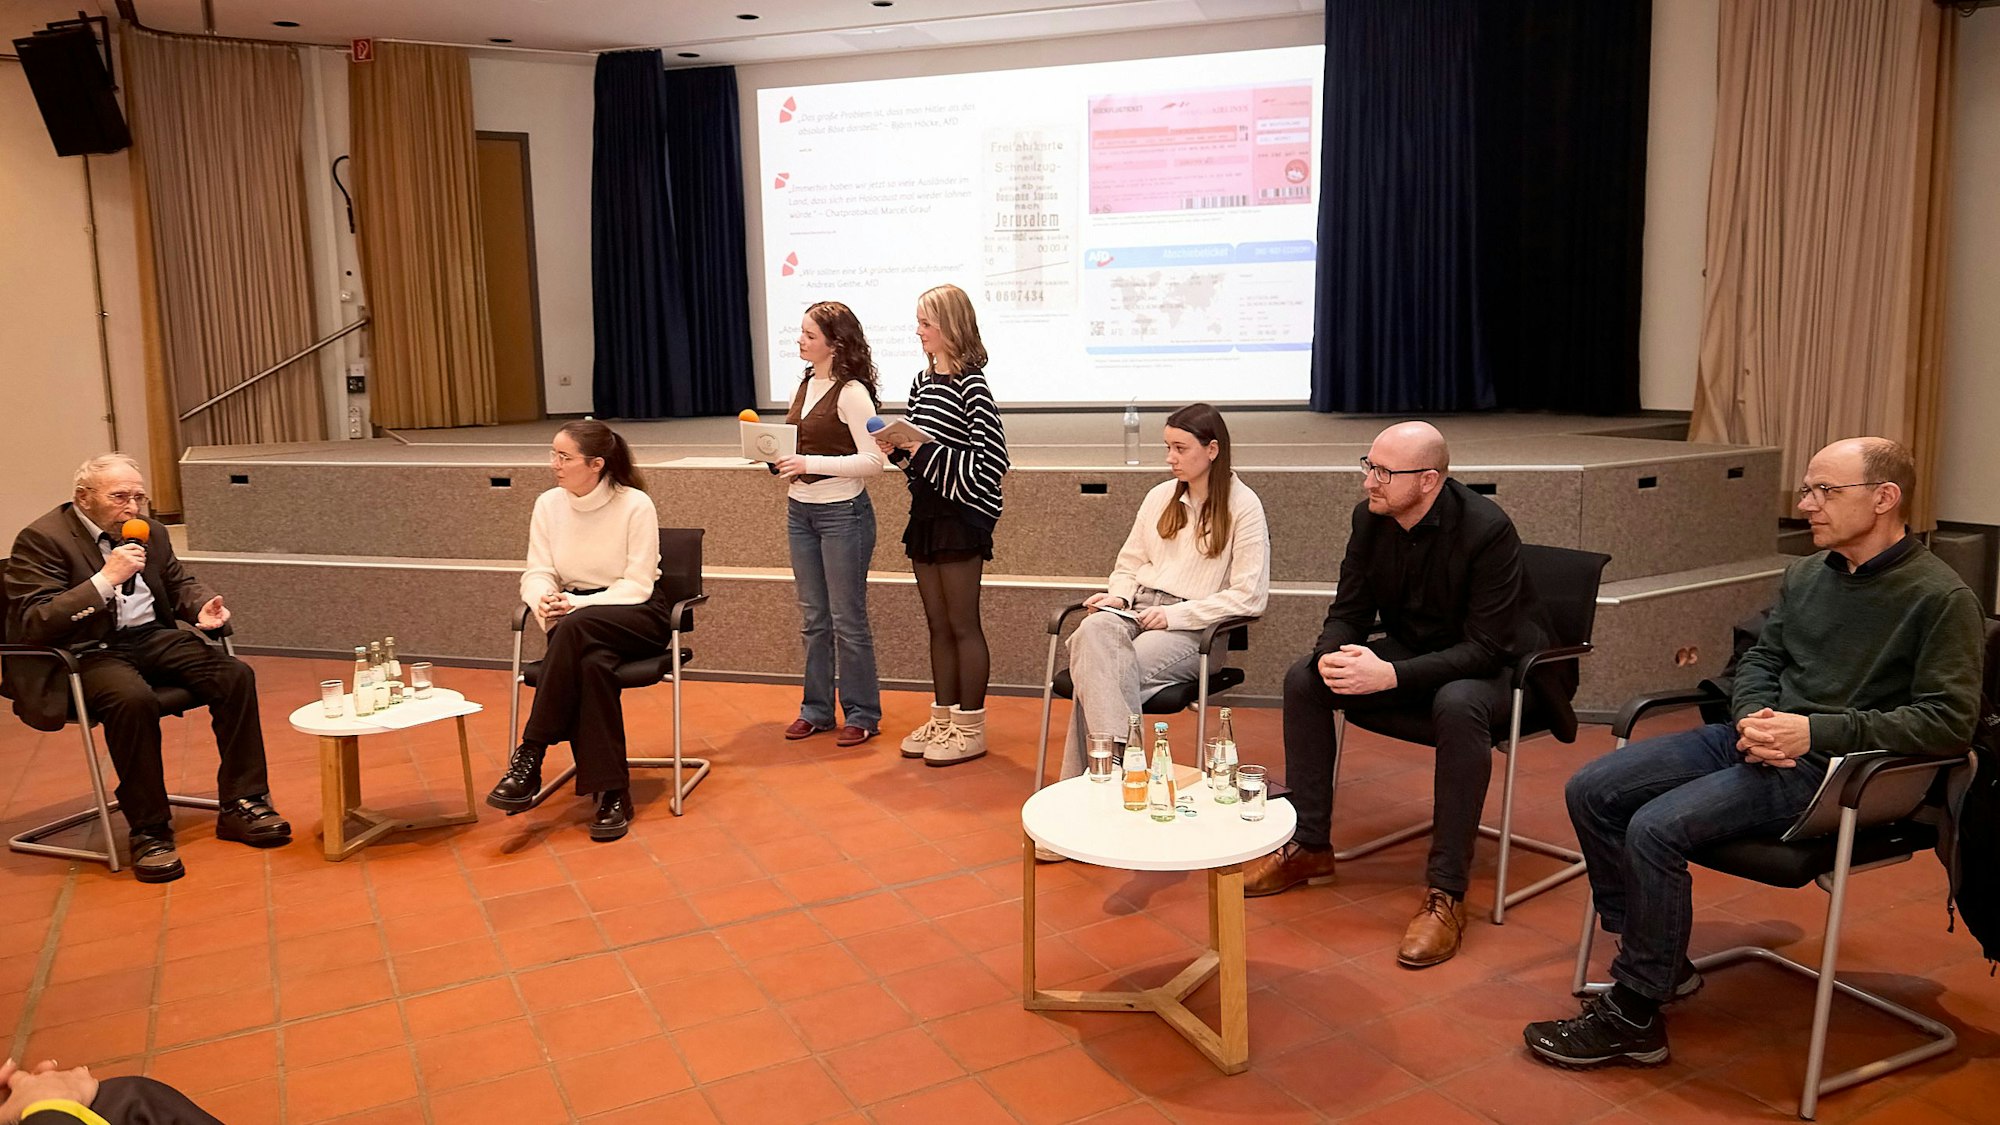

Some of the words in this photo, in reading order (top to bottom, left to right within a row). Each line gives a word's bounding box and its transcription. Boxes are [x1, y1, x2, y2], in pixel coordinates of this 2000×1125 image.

[817, 112, 838, 122] große
[841, 108, 873, 119] Problem
[925, 104, 946, 112] Hitler
[943, 116, 959, 126] AfD
[830, 182, 852, 191] haben
[918, 177, 957, 186] Ausländer
[829, 194, 844, 204] sich
[859, 192, 898, 203] Holocaust
[917, 190, 942, 200] wieder
[944, 188, 972, 198] lohnen
[825, 206, 879, 219] Chatprotokoll
[881, 205, 909, 215] Marcel
[1014, 203, 1040, 211] nach
[995, 211, 1059, 227] Jerusalem
[817, 265, 840, 275] sollten
[842, 266, 857, 275] eine
[858, 265, 868, 275] SA
[901, 264, 916, 273] und
[806, 280, 835, 288] Andreas
[864, 278, 879, 288] AfD
